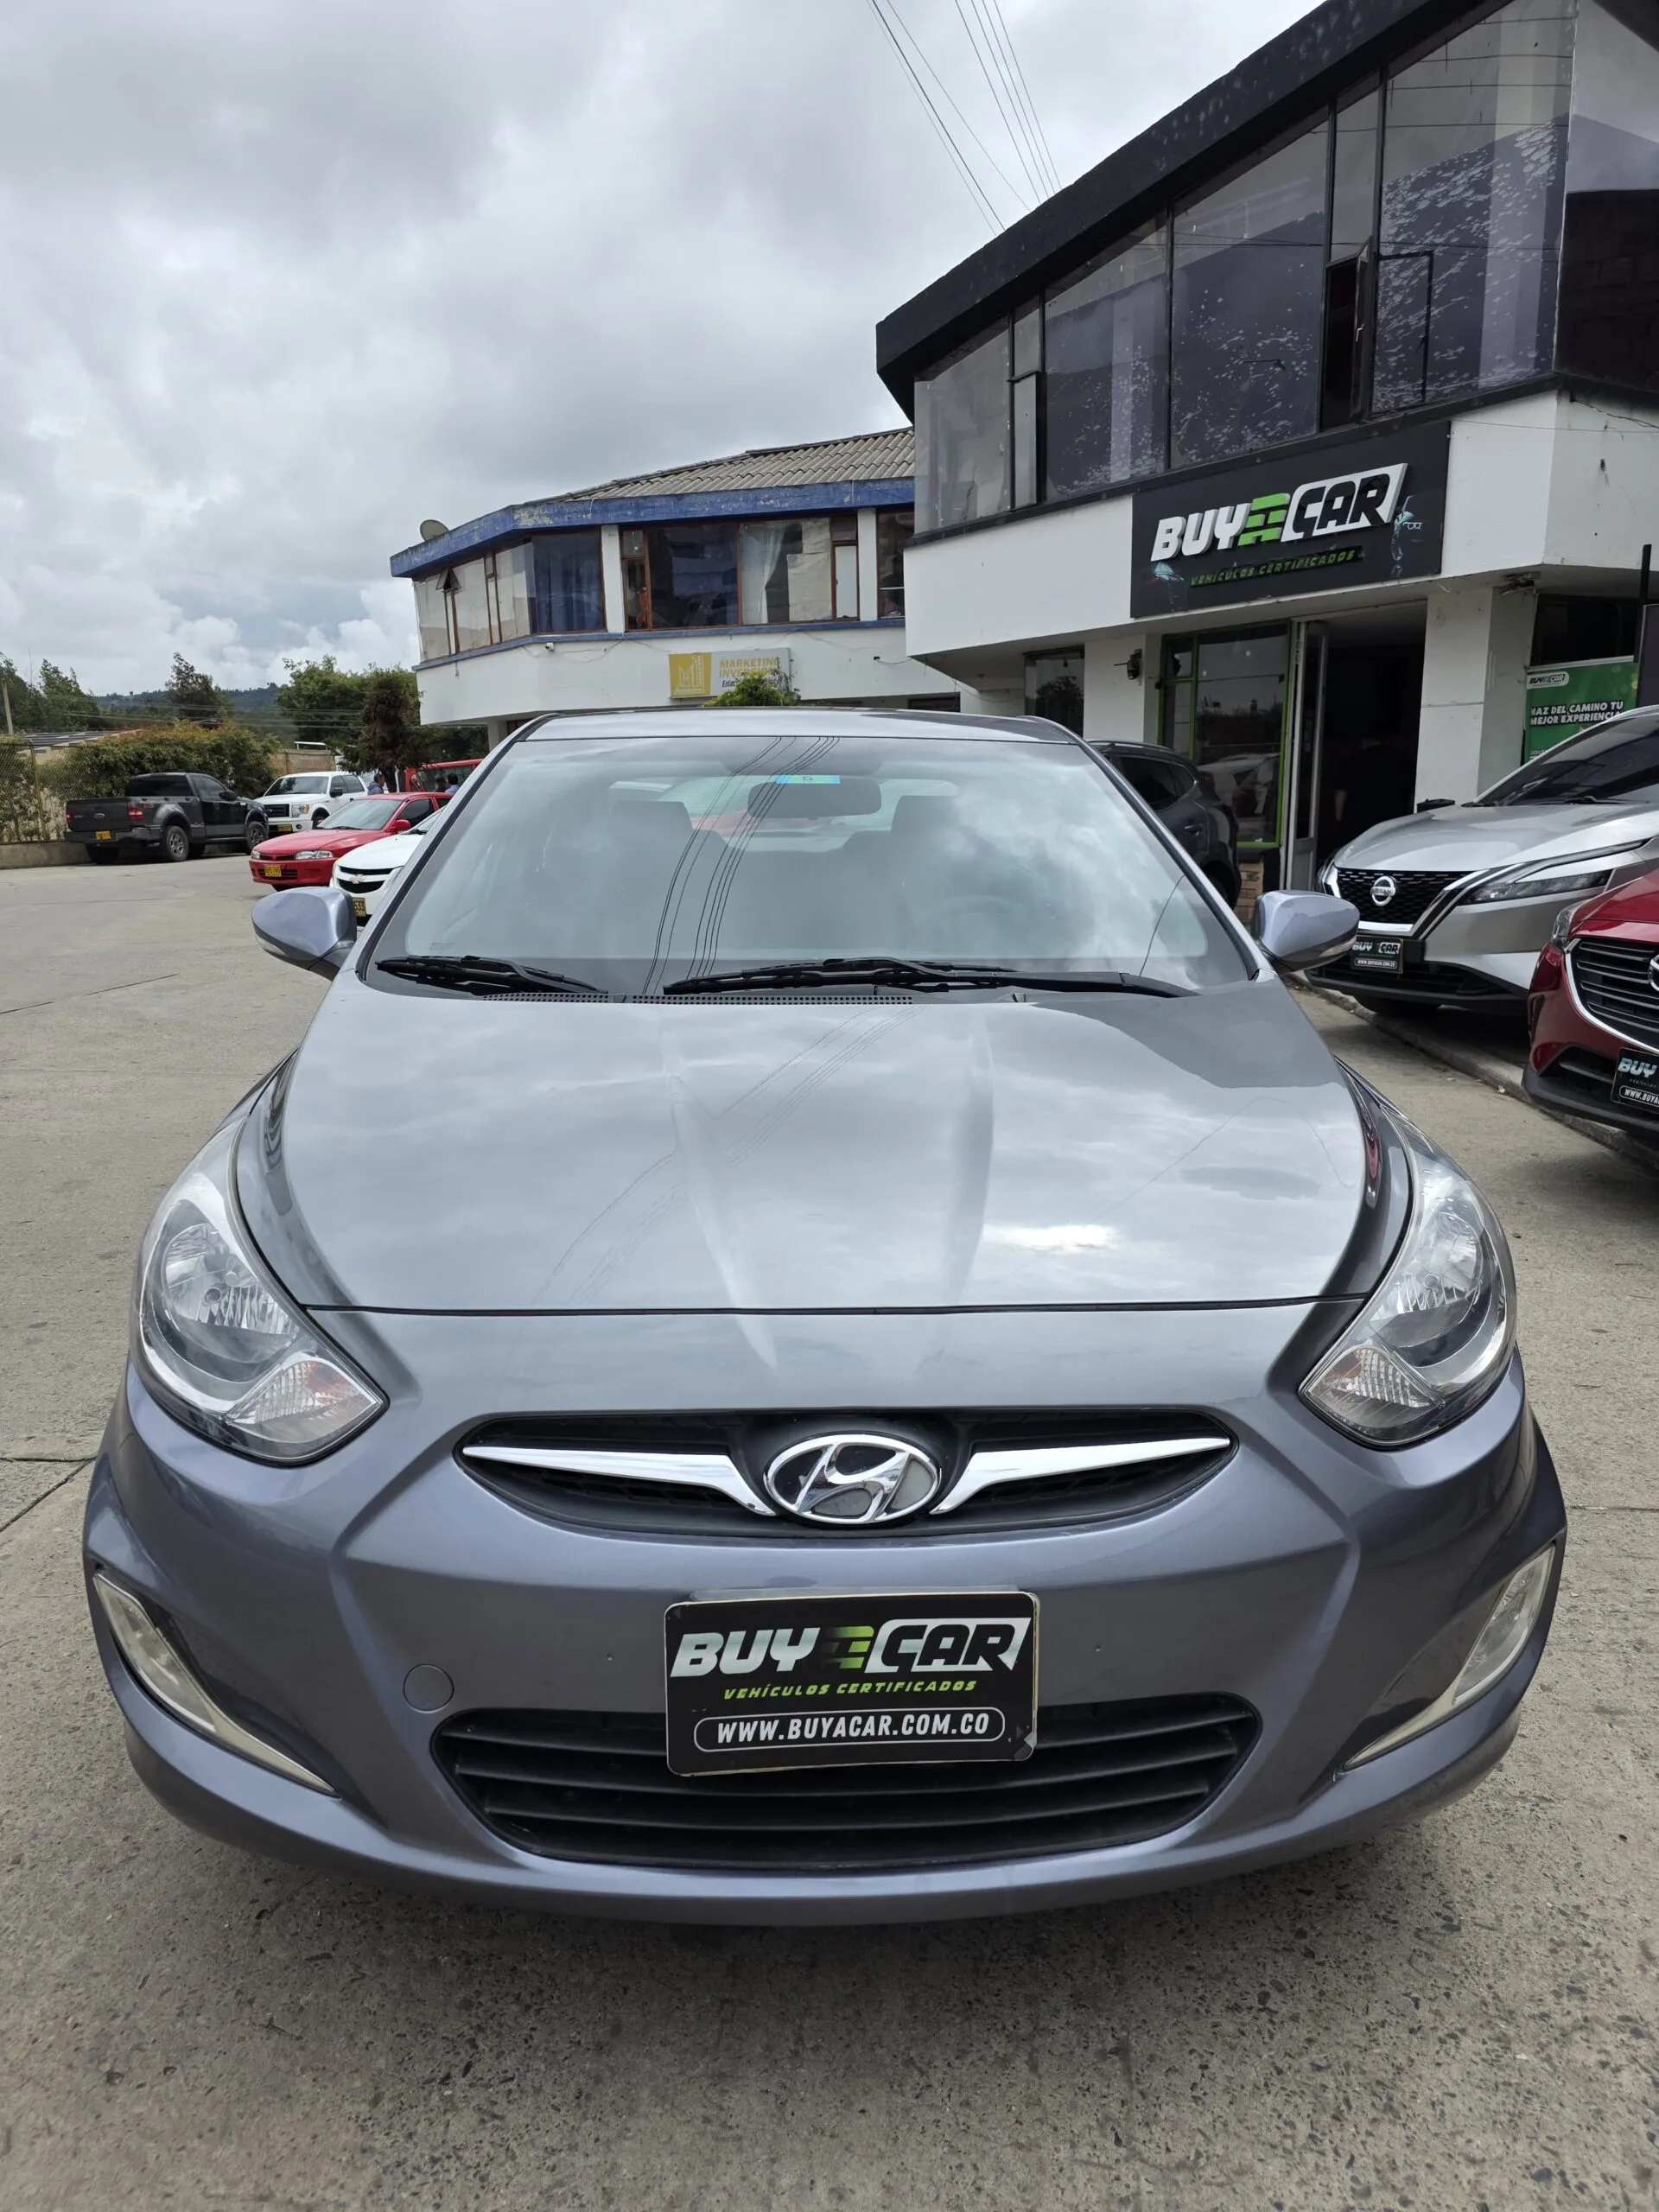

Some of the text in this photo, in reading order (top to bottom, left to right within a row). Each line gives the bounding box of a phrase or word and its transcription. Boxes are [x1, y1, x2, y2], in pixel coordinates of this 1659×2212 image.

[1258, 549, 1356, 575] CERTIFICADOS
[1551, 705, 1566, 715] DEL
[1569, 702, 1608, 713] CAMINO
[1611, 701, 1624, 709] TU
[1530, 716, 1559, 725] MEJOR
[1618, 1057, 1657, 1078] BUY
[670, 1626, 821, 1678] BUY
[874, 1620, 1027, 1673] CAR
[723, 1679, 978, 1700] VEHÍCULOS CERTIFICADOS
[717, 1712, 990, 1744] WWW.BUYACAR.COM.CO
